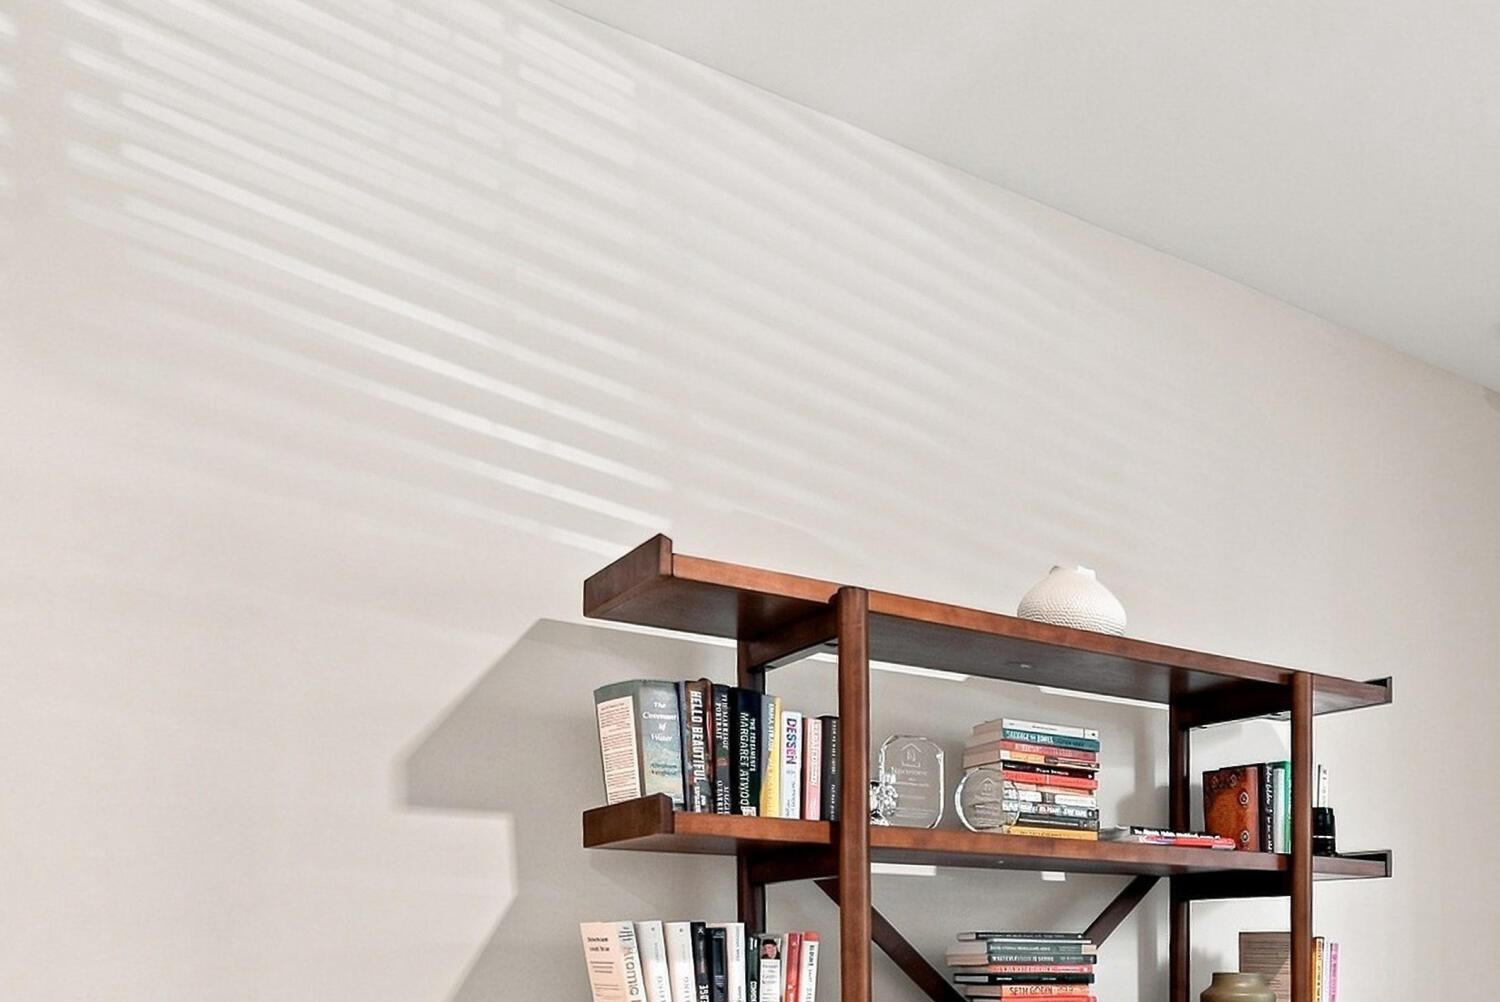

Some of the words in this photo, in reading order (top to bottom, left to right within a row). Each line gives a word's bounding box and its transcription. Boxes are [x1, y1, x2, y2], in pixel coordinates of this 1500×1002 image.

[690, 690, 703, 723] HELLO
[691, 726, 706, 785] BEAUTIFUL
[739, 712, 749, 767] MARGARET
[739, 769, 749, 807] ATWOO
[623, 947, 639, 996] Atomic
